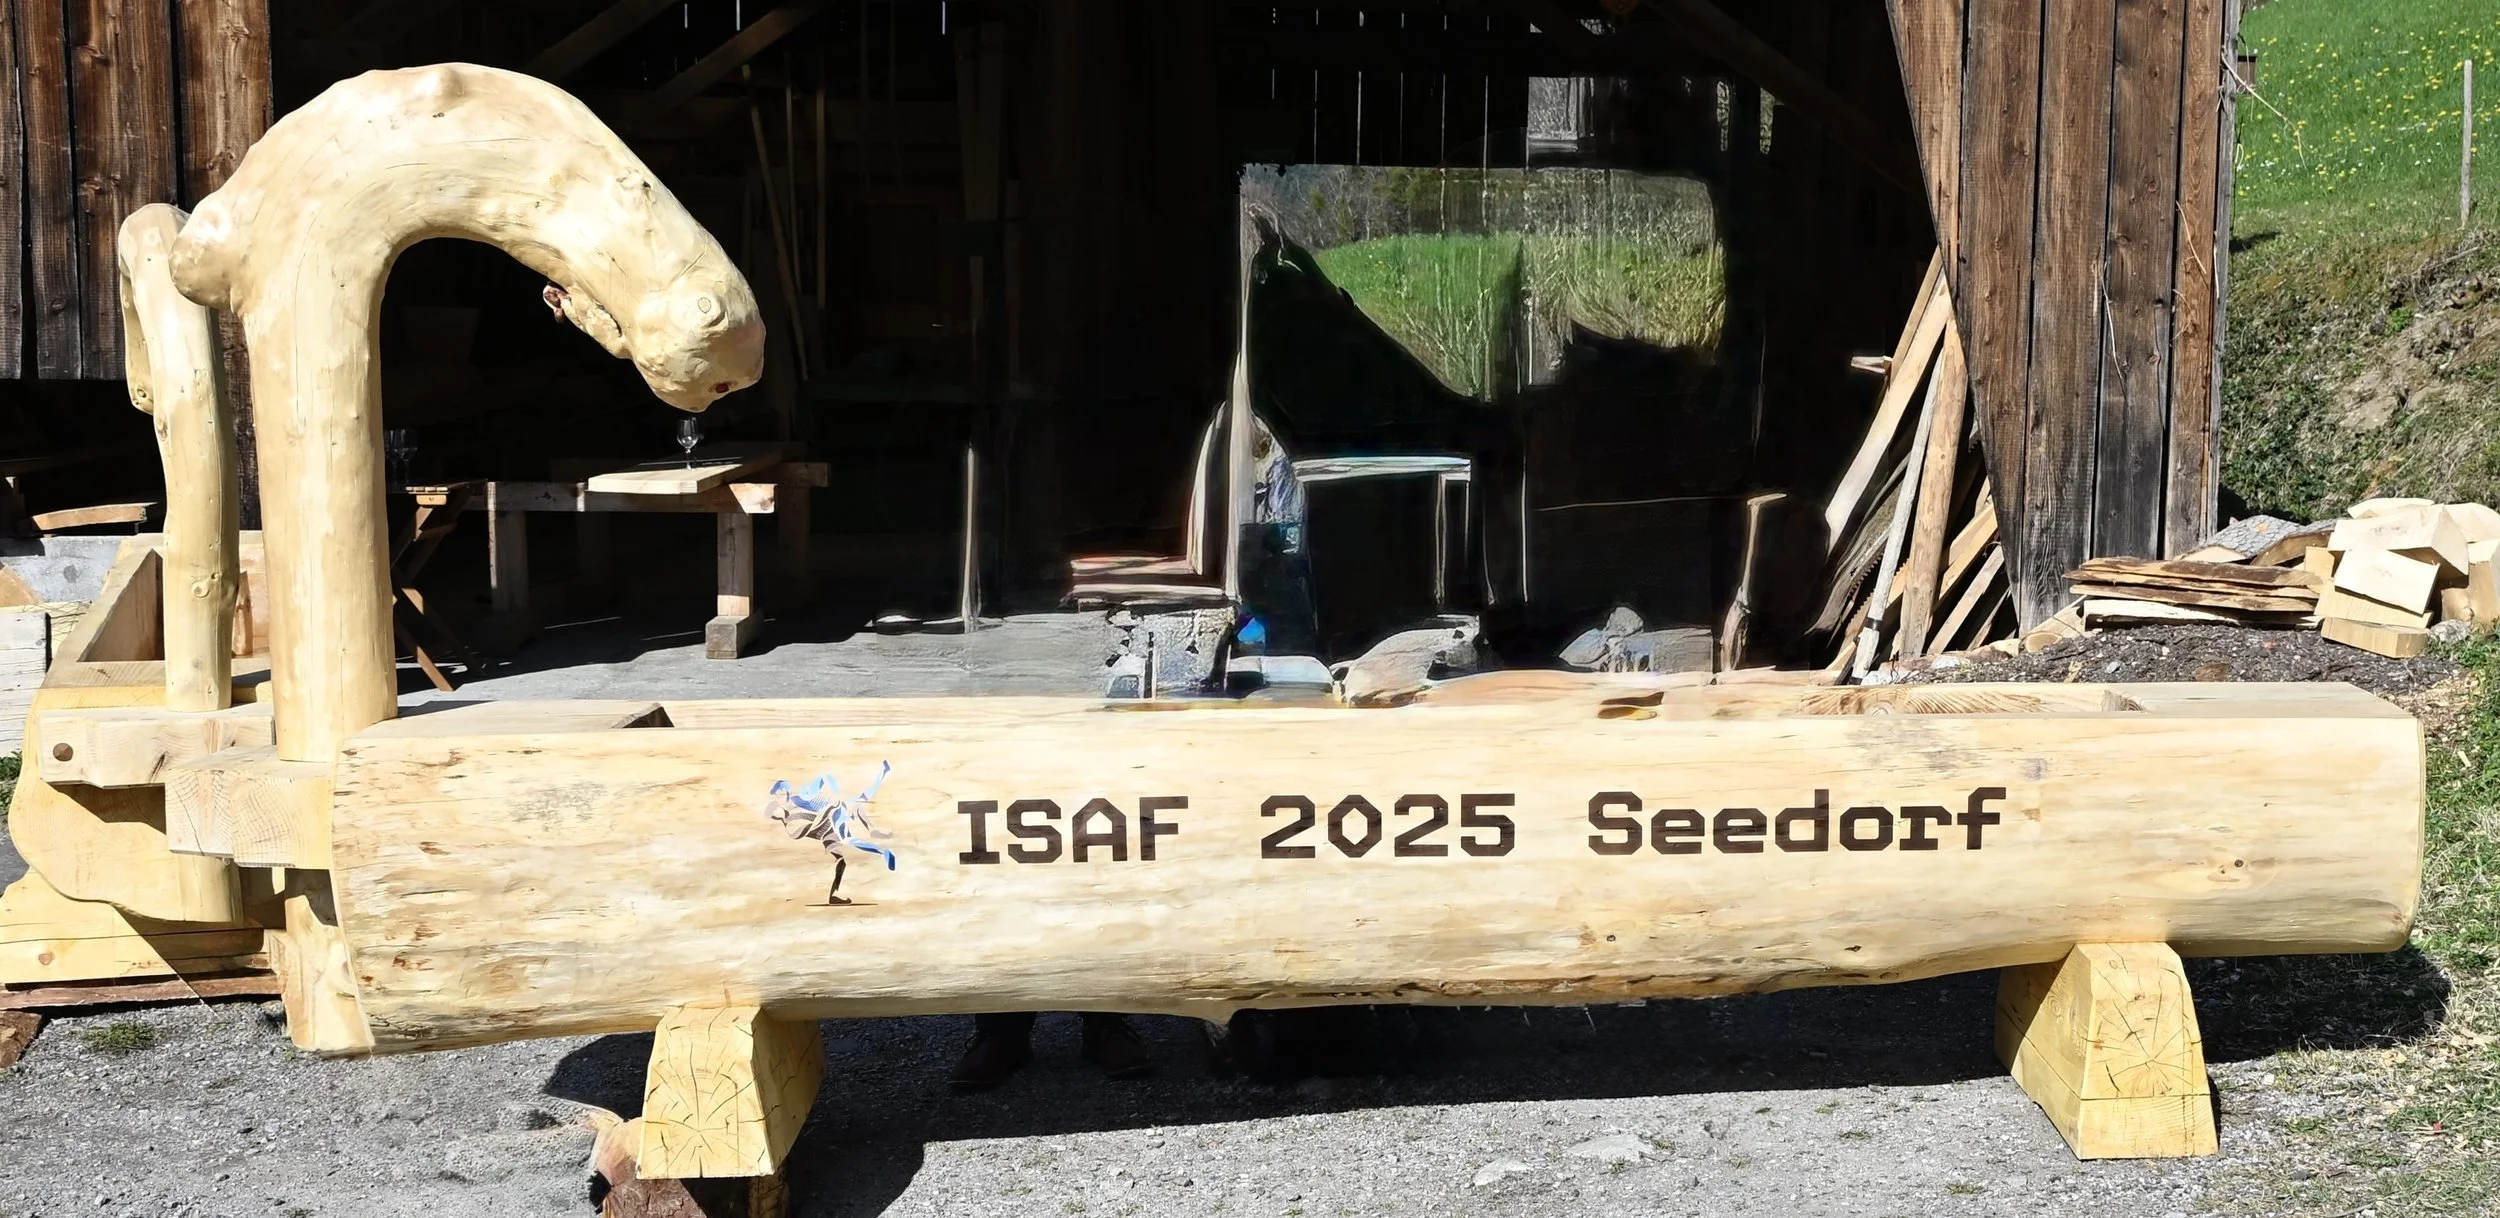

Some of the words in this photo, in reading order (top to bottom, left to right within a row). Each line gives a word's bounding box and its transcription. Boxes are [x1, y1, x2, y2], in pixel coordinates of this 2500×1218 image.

[957, 796, 1189, 865] ISAF
[1260, 793, 1515, 859] 2025
[1588, 786, 2007, 855] Seedorf
